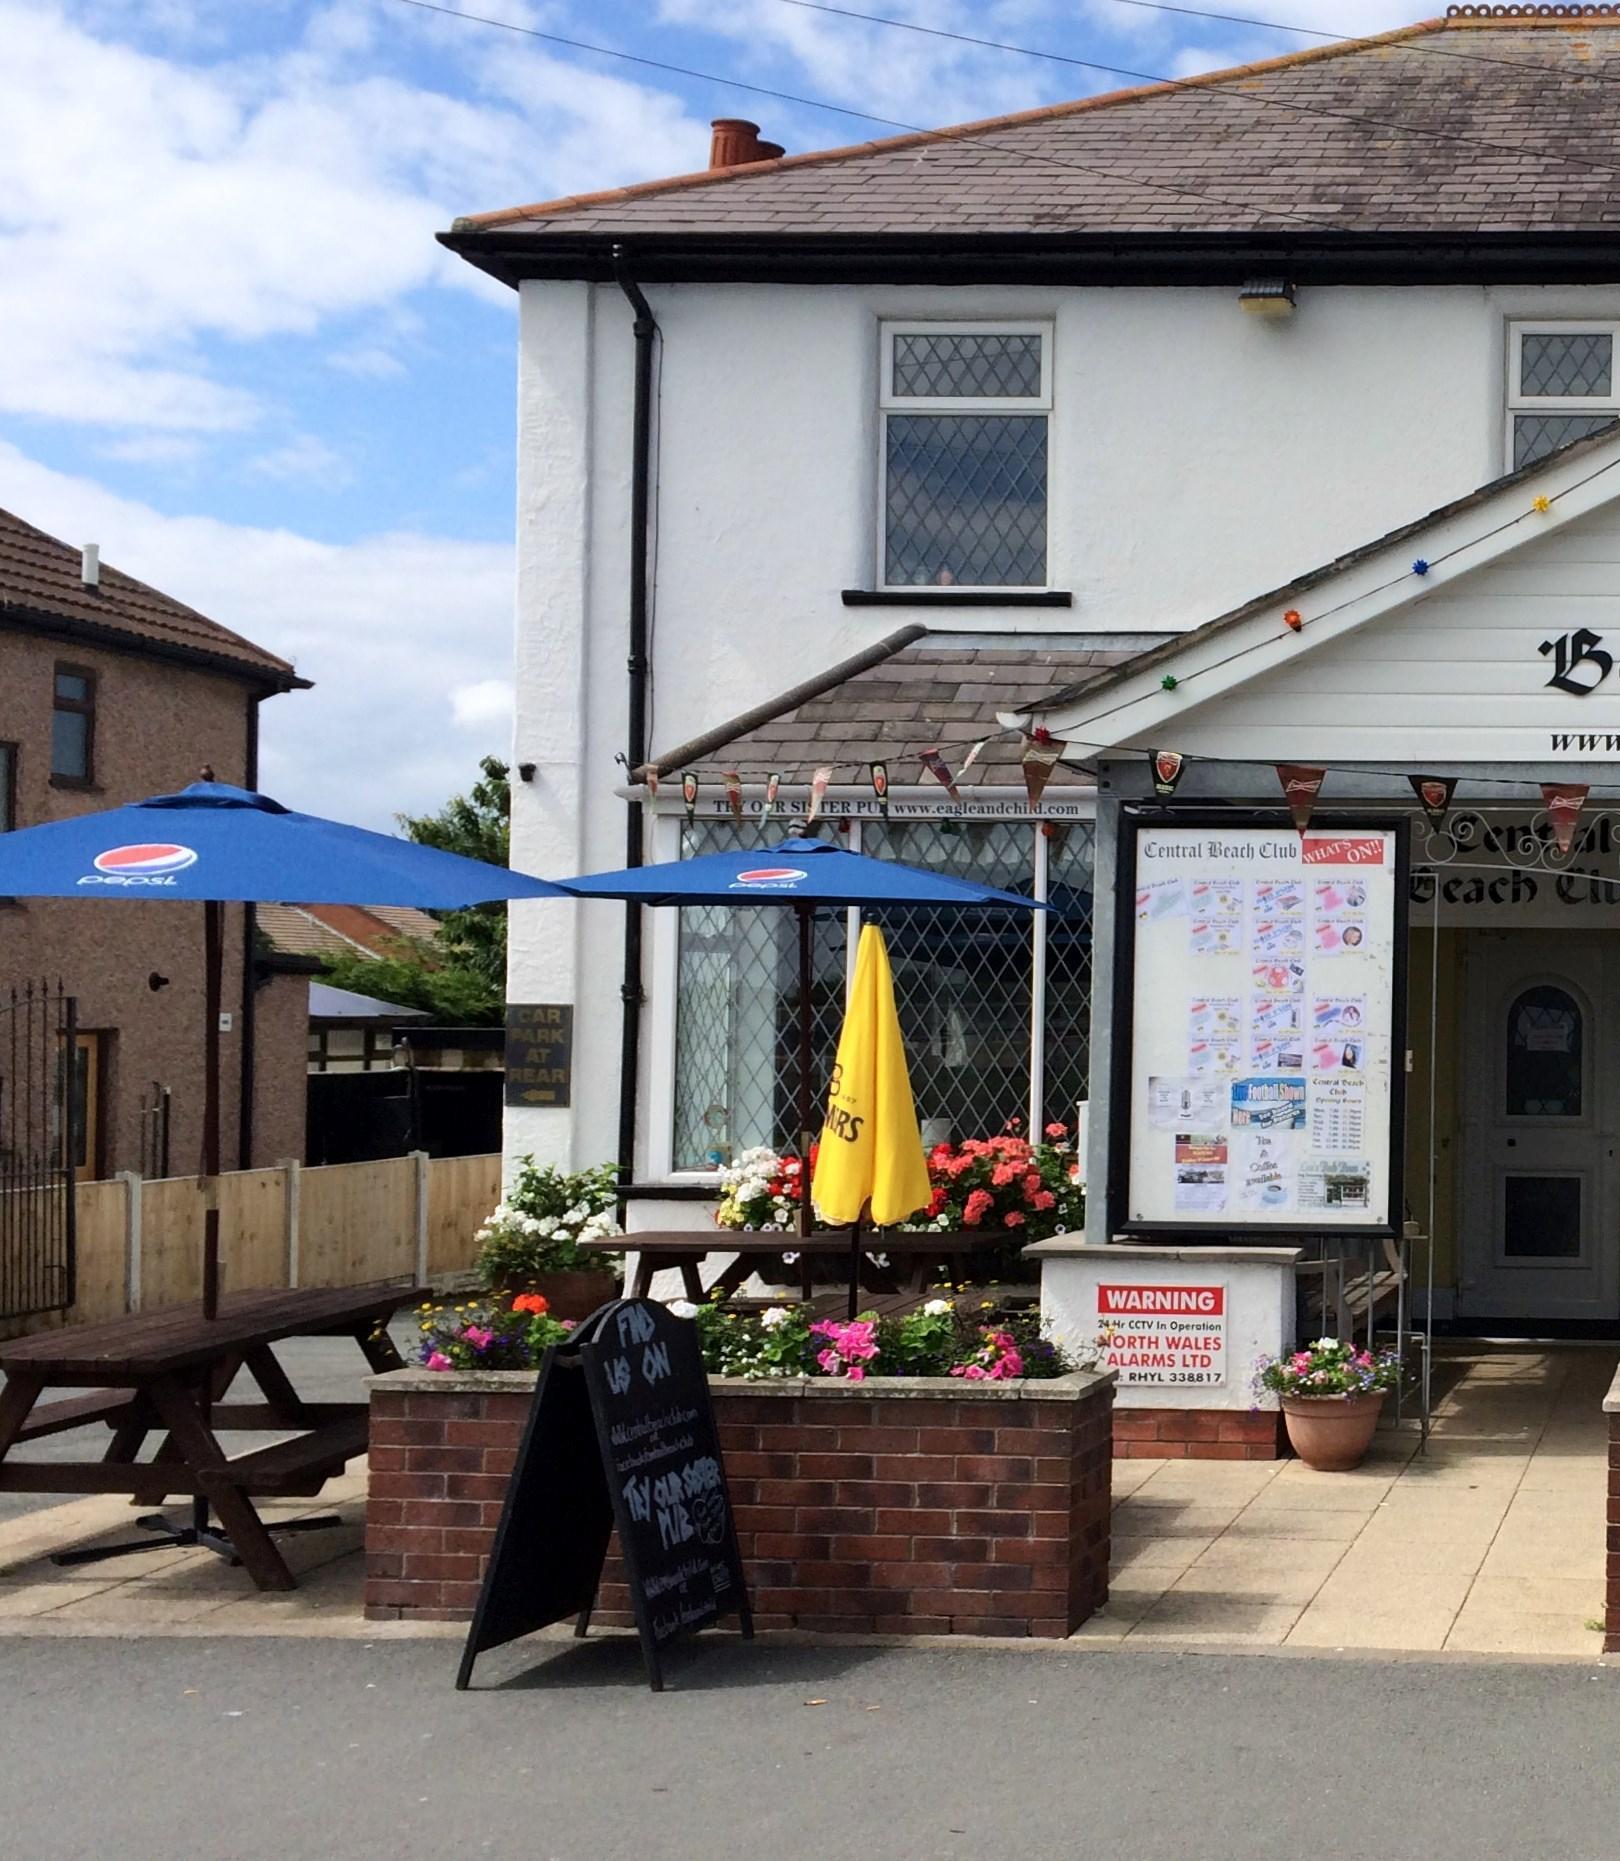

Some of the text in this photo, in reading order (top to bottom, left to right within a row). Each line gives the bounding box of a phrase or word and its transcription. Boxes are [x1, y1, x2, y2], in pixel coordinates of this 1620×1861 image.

[751, 800, 785, 813] OR
[790, 800, 850, 813] SITER
[857, 801, 885, 814] PU
[1451, 816, 1611, 853] Cental
[1144, 841, 1298, 860] Central Beach Club
[1303, 839, 1352, 864] WHAT'S
[1347, 840, 1383, 863] ON!!
[76, 875, 177, 887] pepsi
[1410, 867, 1538, 904] Beach
[519, 1008, 561, 1023] CAR
[511, 1027, 565, 1043] PARK
[527, 1047, 551, 1063] AT
[510, 1067, 566, 1083] REAR
[1107, 1290, 1215, 1311] WARNING
[1128, 1320, 1154, 1329] CCTV
[1157, 1321, 1167, 1329] In
[1170, 1321, 1221, 1332] Operation
[1165, 1336, 1221, 1351] WALES
[642, 1342, 671, 1385] ON
[1107, 1352, 1211, 1368] ALARMS LTD
[1129, 1372, 1165, 1382] RHYL
[1169, 1373, 1221, 1383] 338817
[622, 1474, 651, 1522] TRY
[654, 1470, 686, 1506] OUR
[656, 1502, 695, 1550] PUB
